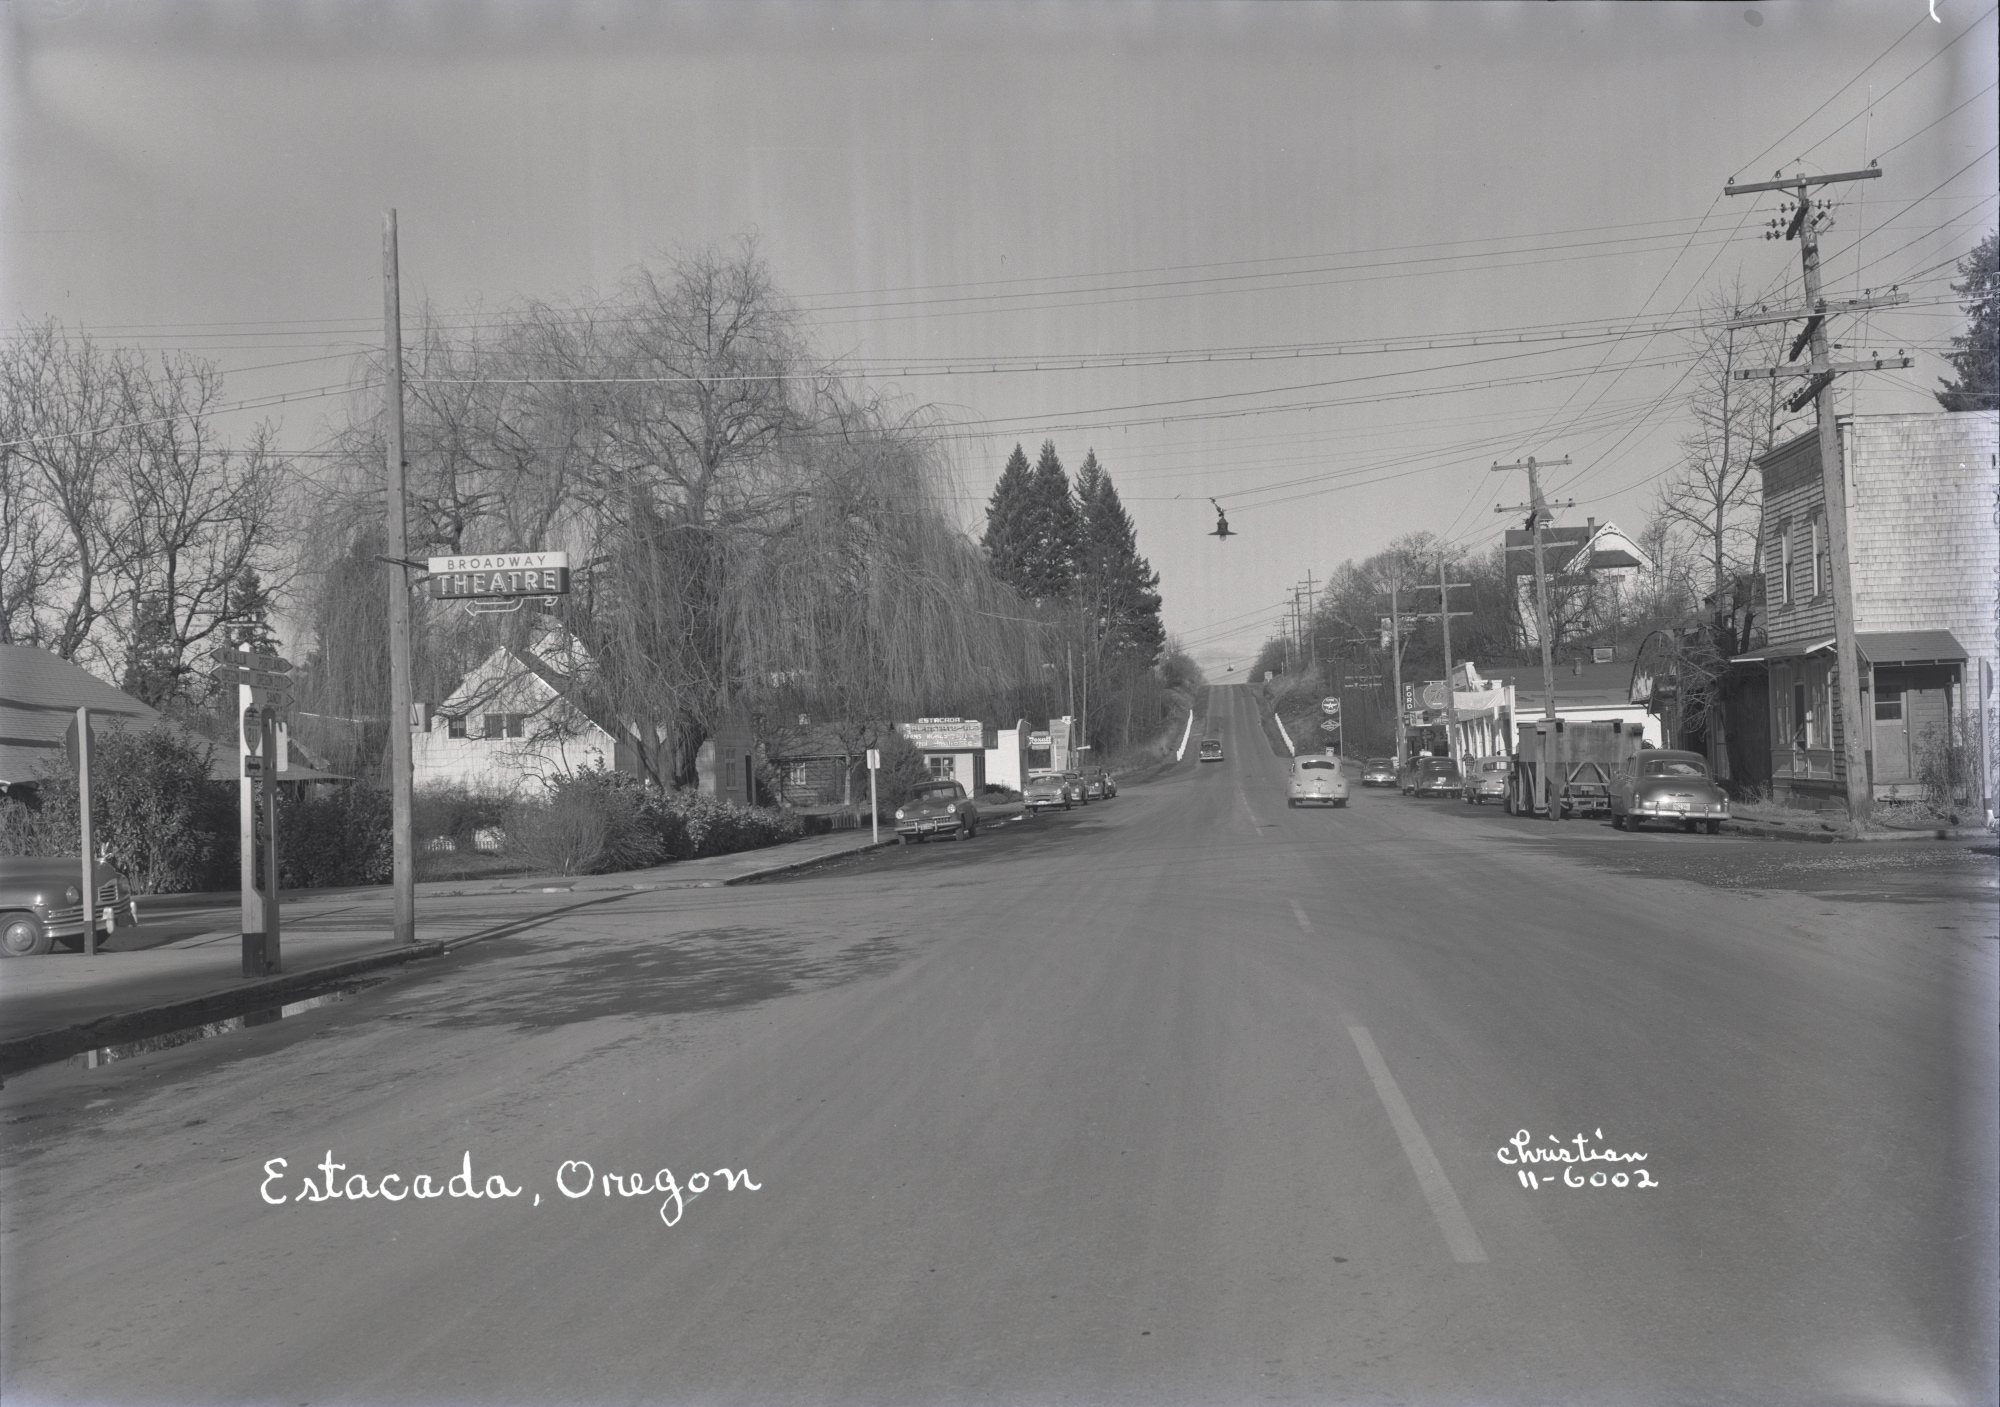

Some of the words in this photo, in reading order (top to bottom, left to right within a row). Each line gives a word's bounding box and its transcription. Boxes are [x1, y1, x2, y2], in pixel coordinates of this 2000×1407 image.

[447, 555, 546, 570] BROADWAY
[437, 570, 556, 595] THEATRE
[259, 657, 284, 671] PORTLAND
[222, 669, 240, 682] OREGON
[241, 671, 251, 684] CITY
[257, 673, 273, 686] OREGON
[274, 675, 284, 688] CITY
[266, 691, 282, 704] SANDY
[1405, 685, 1413, 709] FORD
[1429, 689, 1445, 702] 76
[248, 728, 258, 742] 211
[1028, 736, 1051, 745] Rexall
